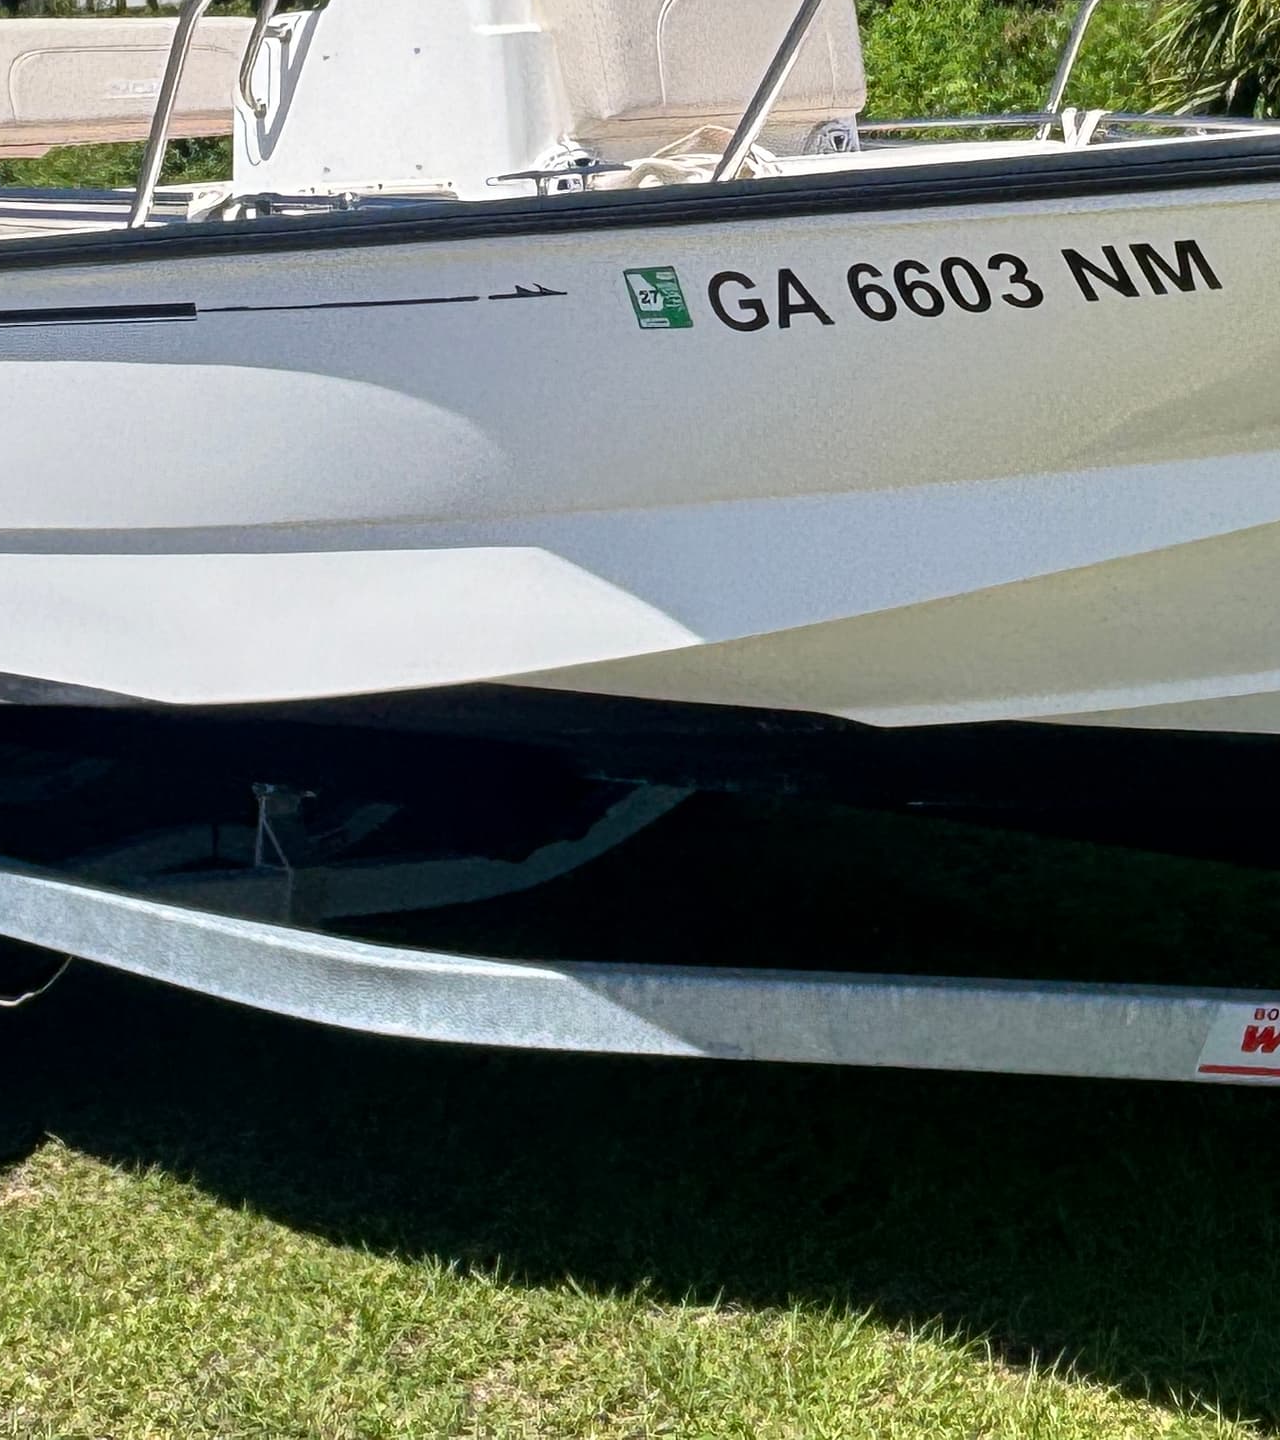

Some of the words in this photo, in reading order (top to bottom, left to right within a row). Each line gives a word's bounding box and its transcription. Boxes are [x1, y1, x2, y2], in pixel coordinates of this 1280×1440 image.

[639, 289, 657, 305] 27
[707, 268, 835, 333] GA
[847, 253, 1045, 322] 6603
[1061, 239, 1224, 302] NM
